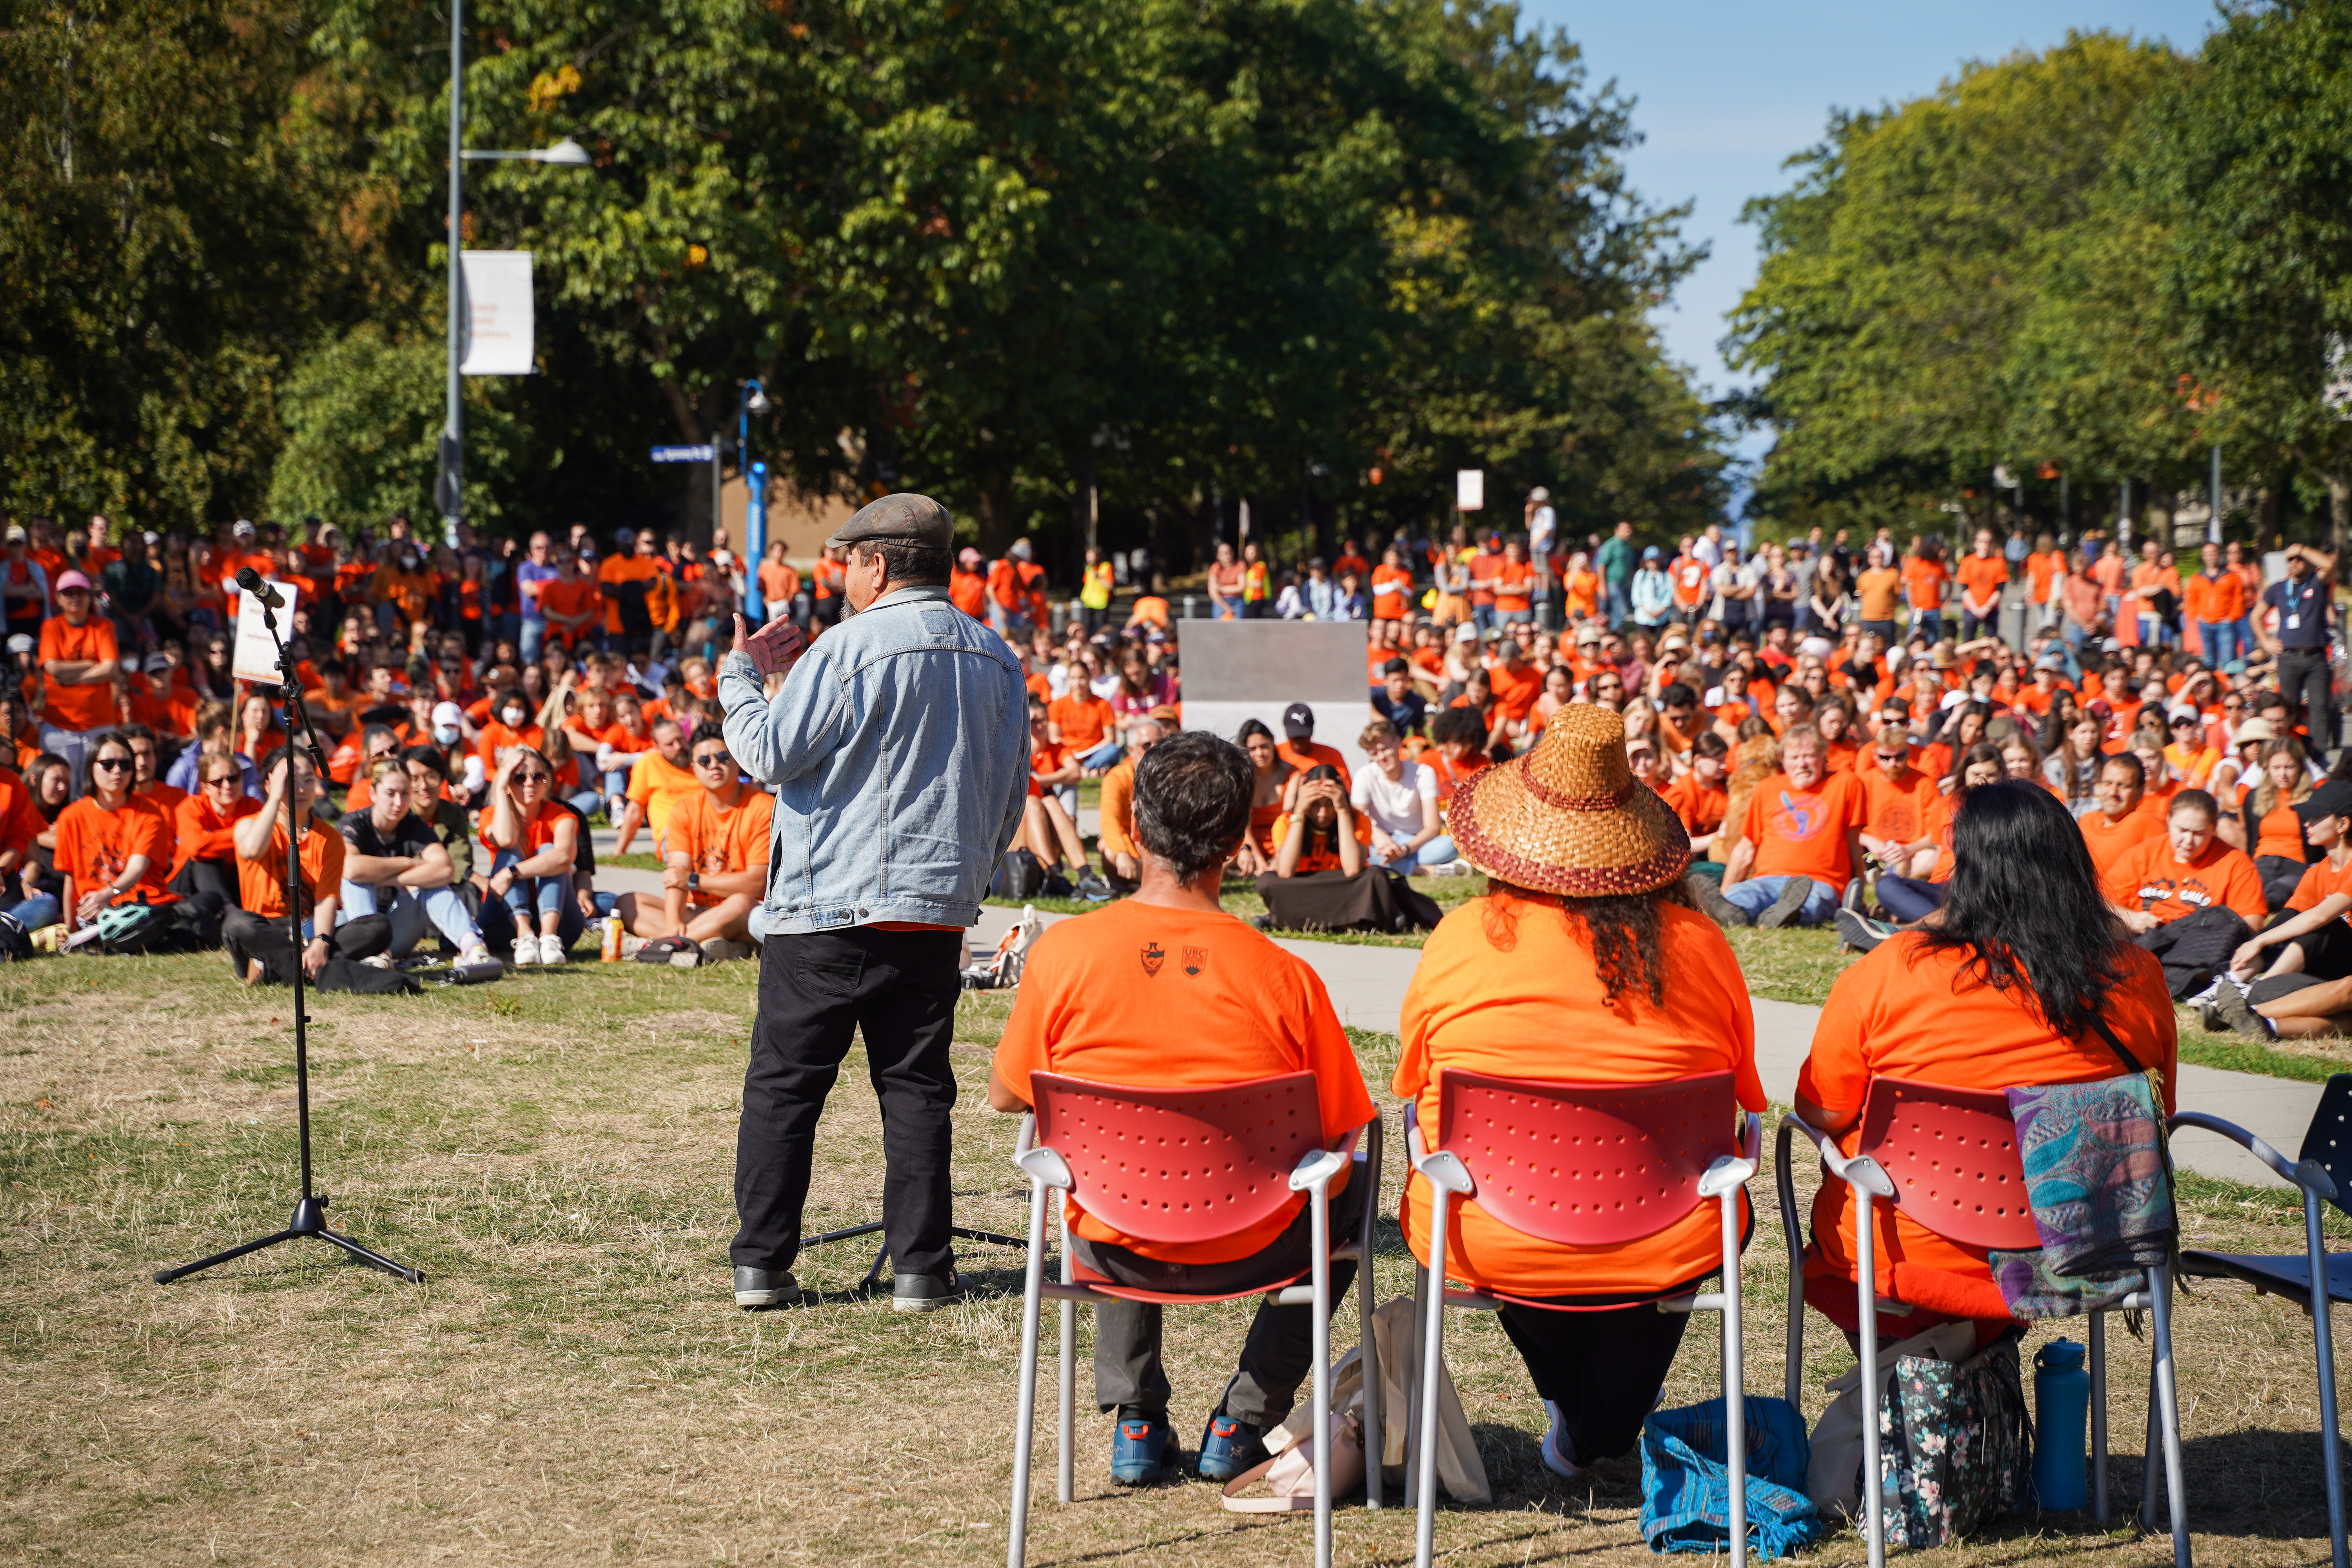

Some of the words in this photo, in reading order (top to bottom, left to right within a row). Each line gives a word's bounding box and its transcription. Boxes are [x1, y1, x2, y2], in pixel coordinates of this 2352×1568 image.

[2138, 887, 2172, 900] EVERY
[2180, 889, 2212, 907] CHILD
[1185, 948, 1205, 957] UBC
